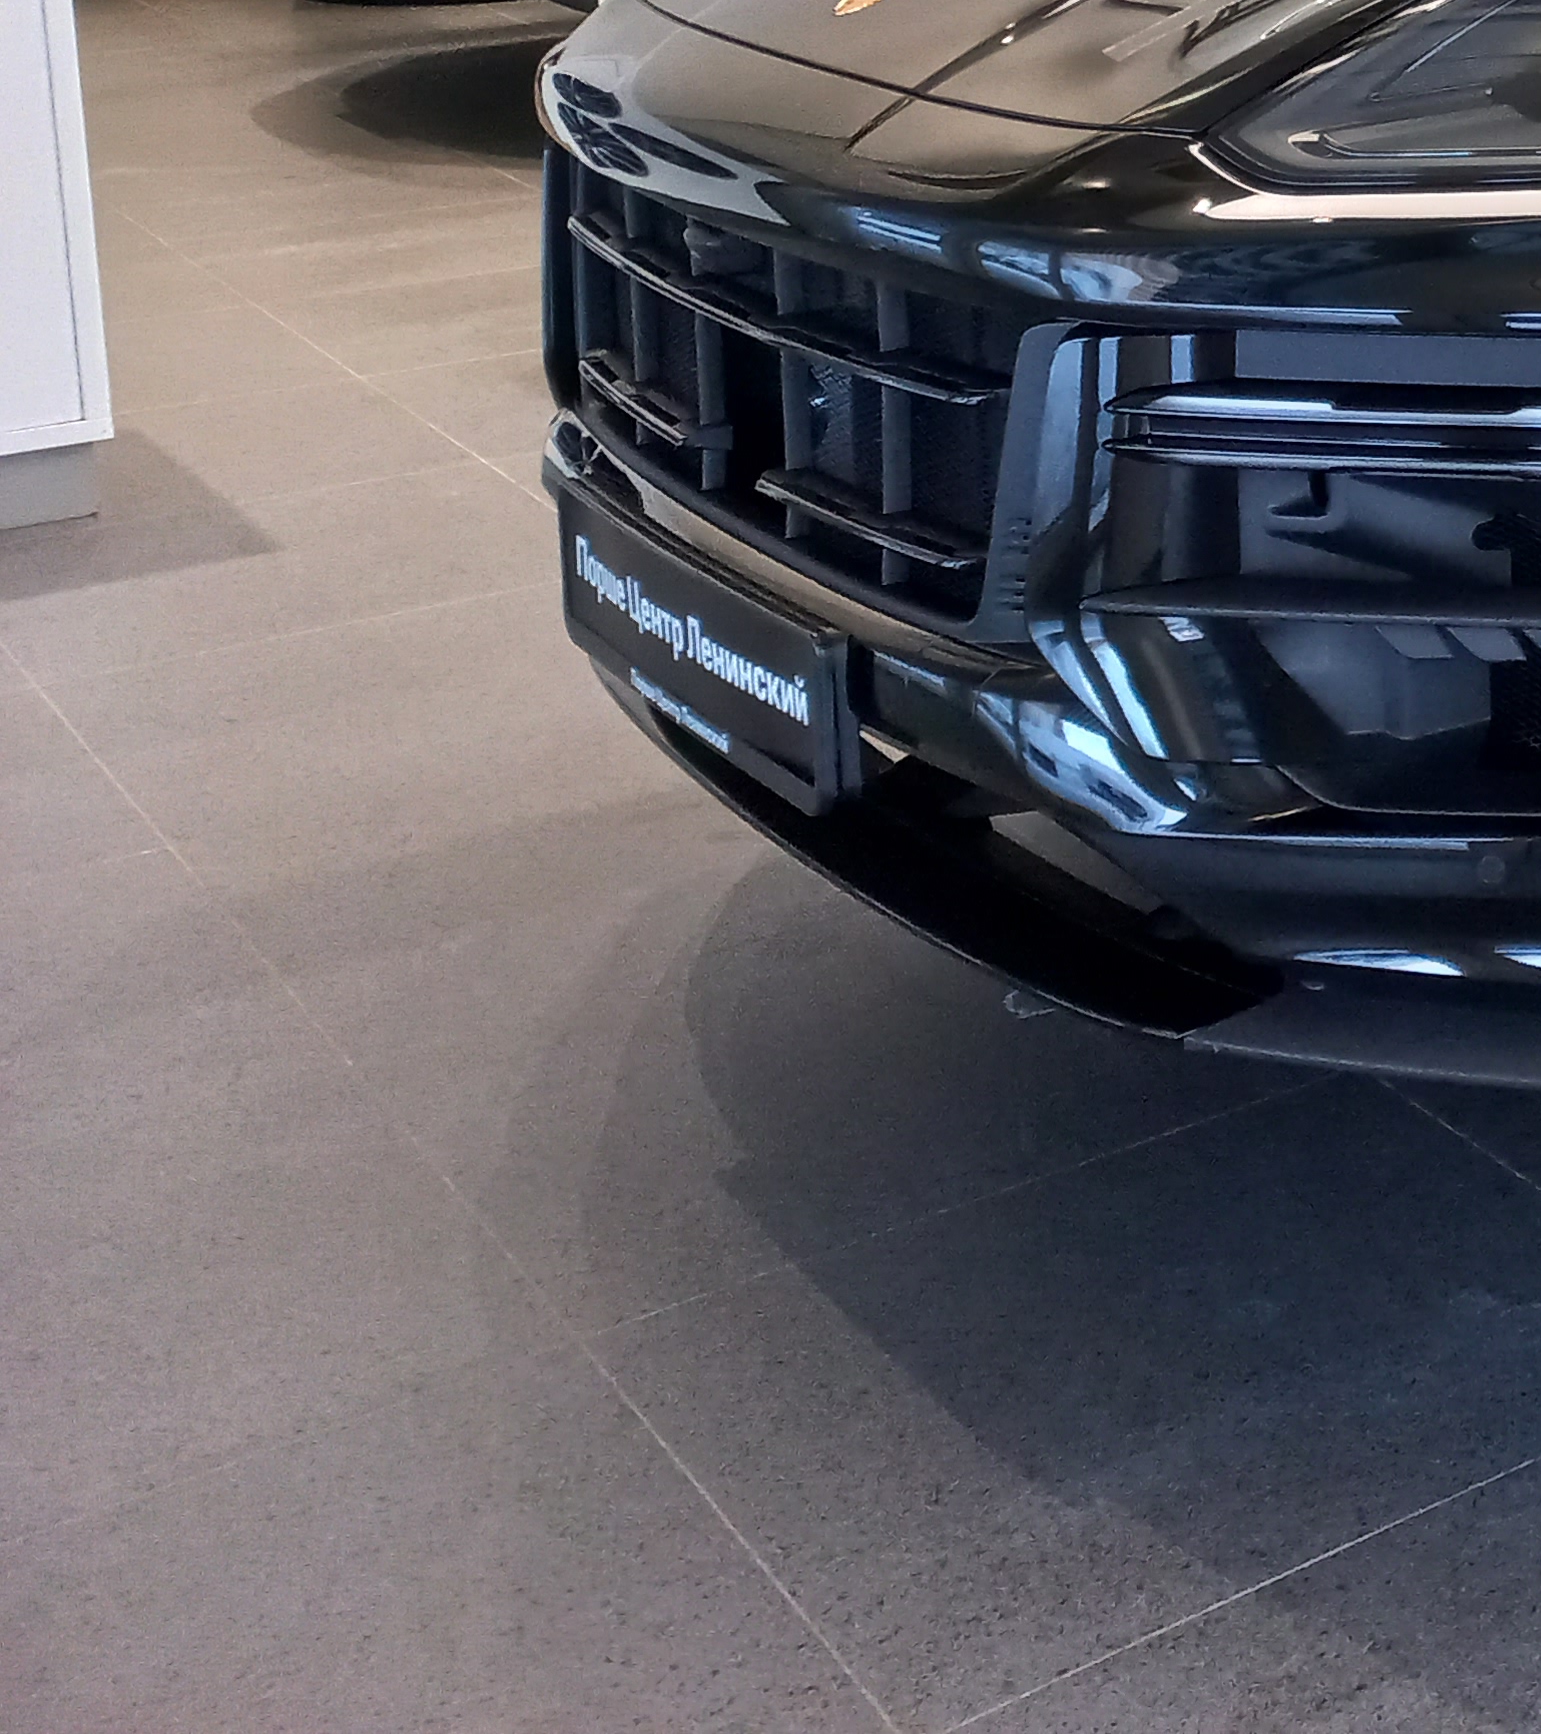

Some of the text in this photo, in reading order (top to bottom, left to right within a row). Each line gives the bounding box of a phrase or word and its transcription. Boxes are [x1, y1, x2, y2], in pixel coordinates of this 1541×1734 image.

[575, 534, 627, 612] Порше
[626, 574, 685, 662] Центр
[686, 614, 810, 727] Ленинский
